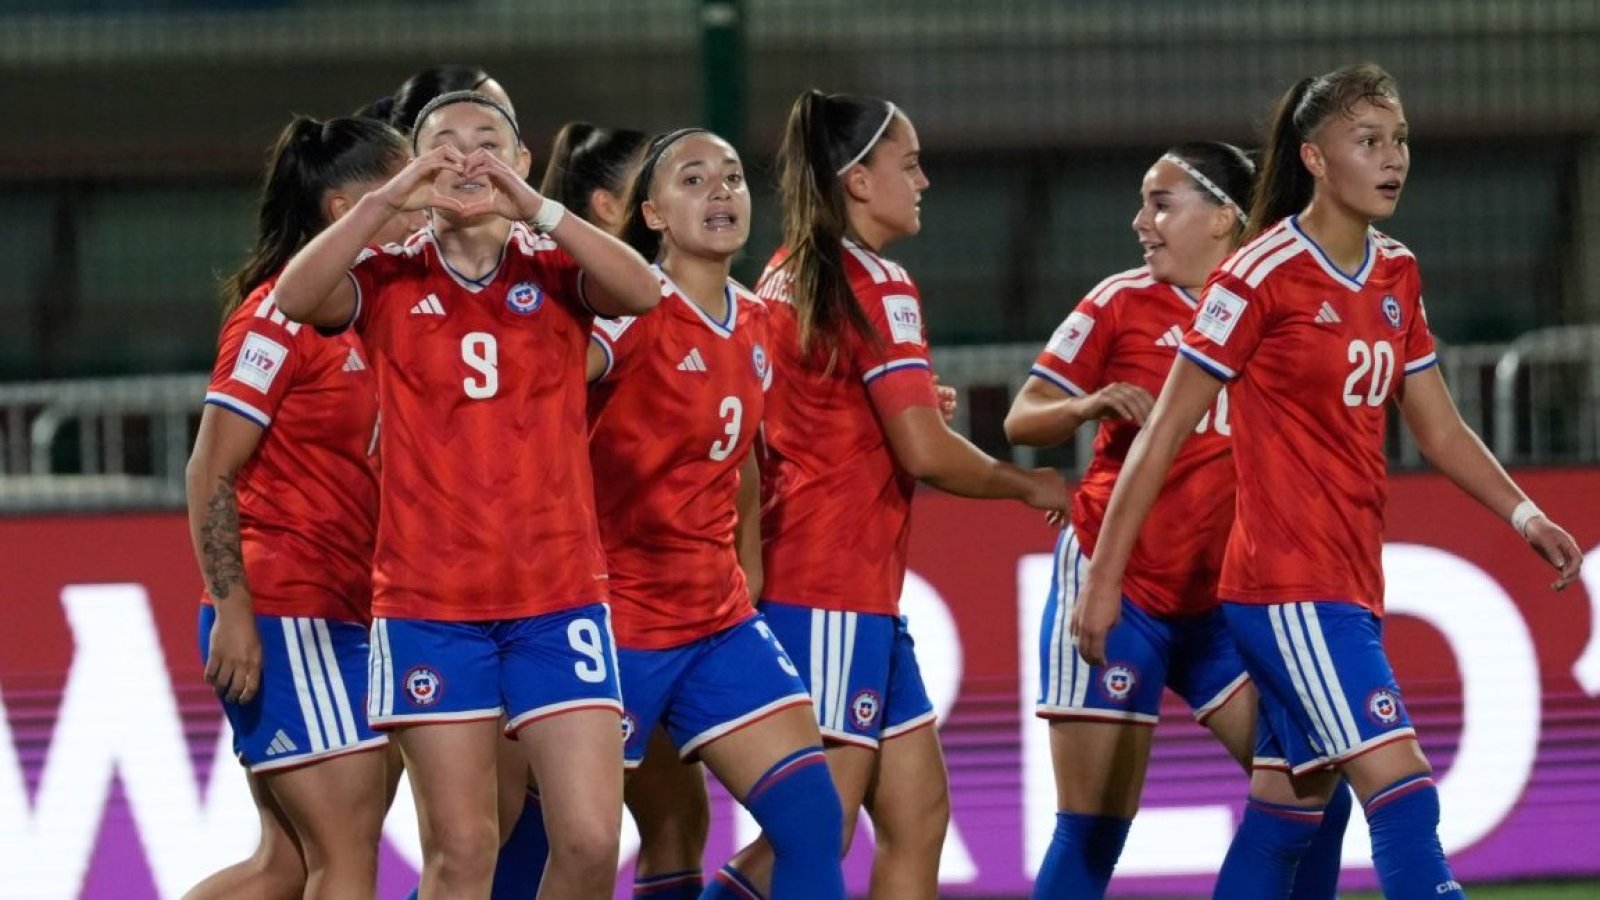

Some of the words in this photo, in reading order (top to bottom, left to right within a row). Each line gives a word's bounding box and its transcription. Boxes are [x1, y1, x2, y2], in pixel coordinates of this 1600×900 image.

[1206, 301, 1232, 322] U17
[244, 349, 275, 371] U17
[461, 332, 498, 399] 9
[1343, 339, 1395, 407] 20
[709, 396, 743, 461] 3
[568, 619, 606, 683] 9
